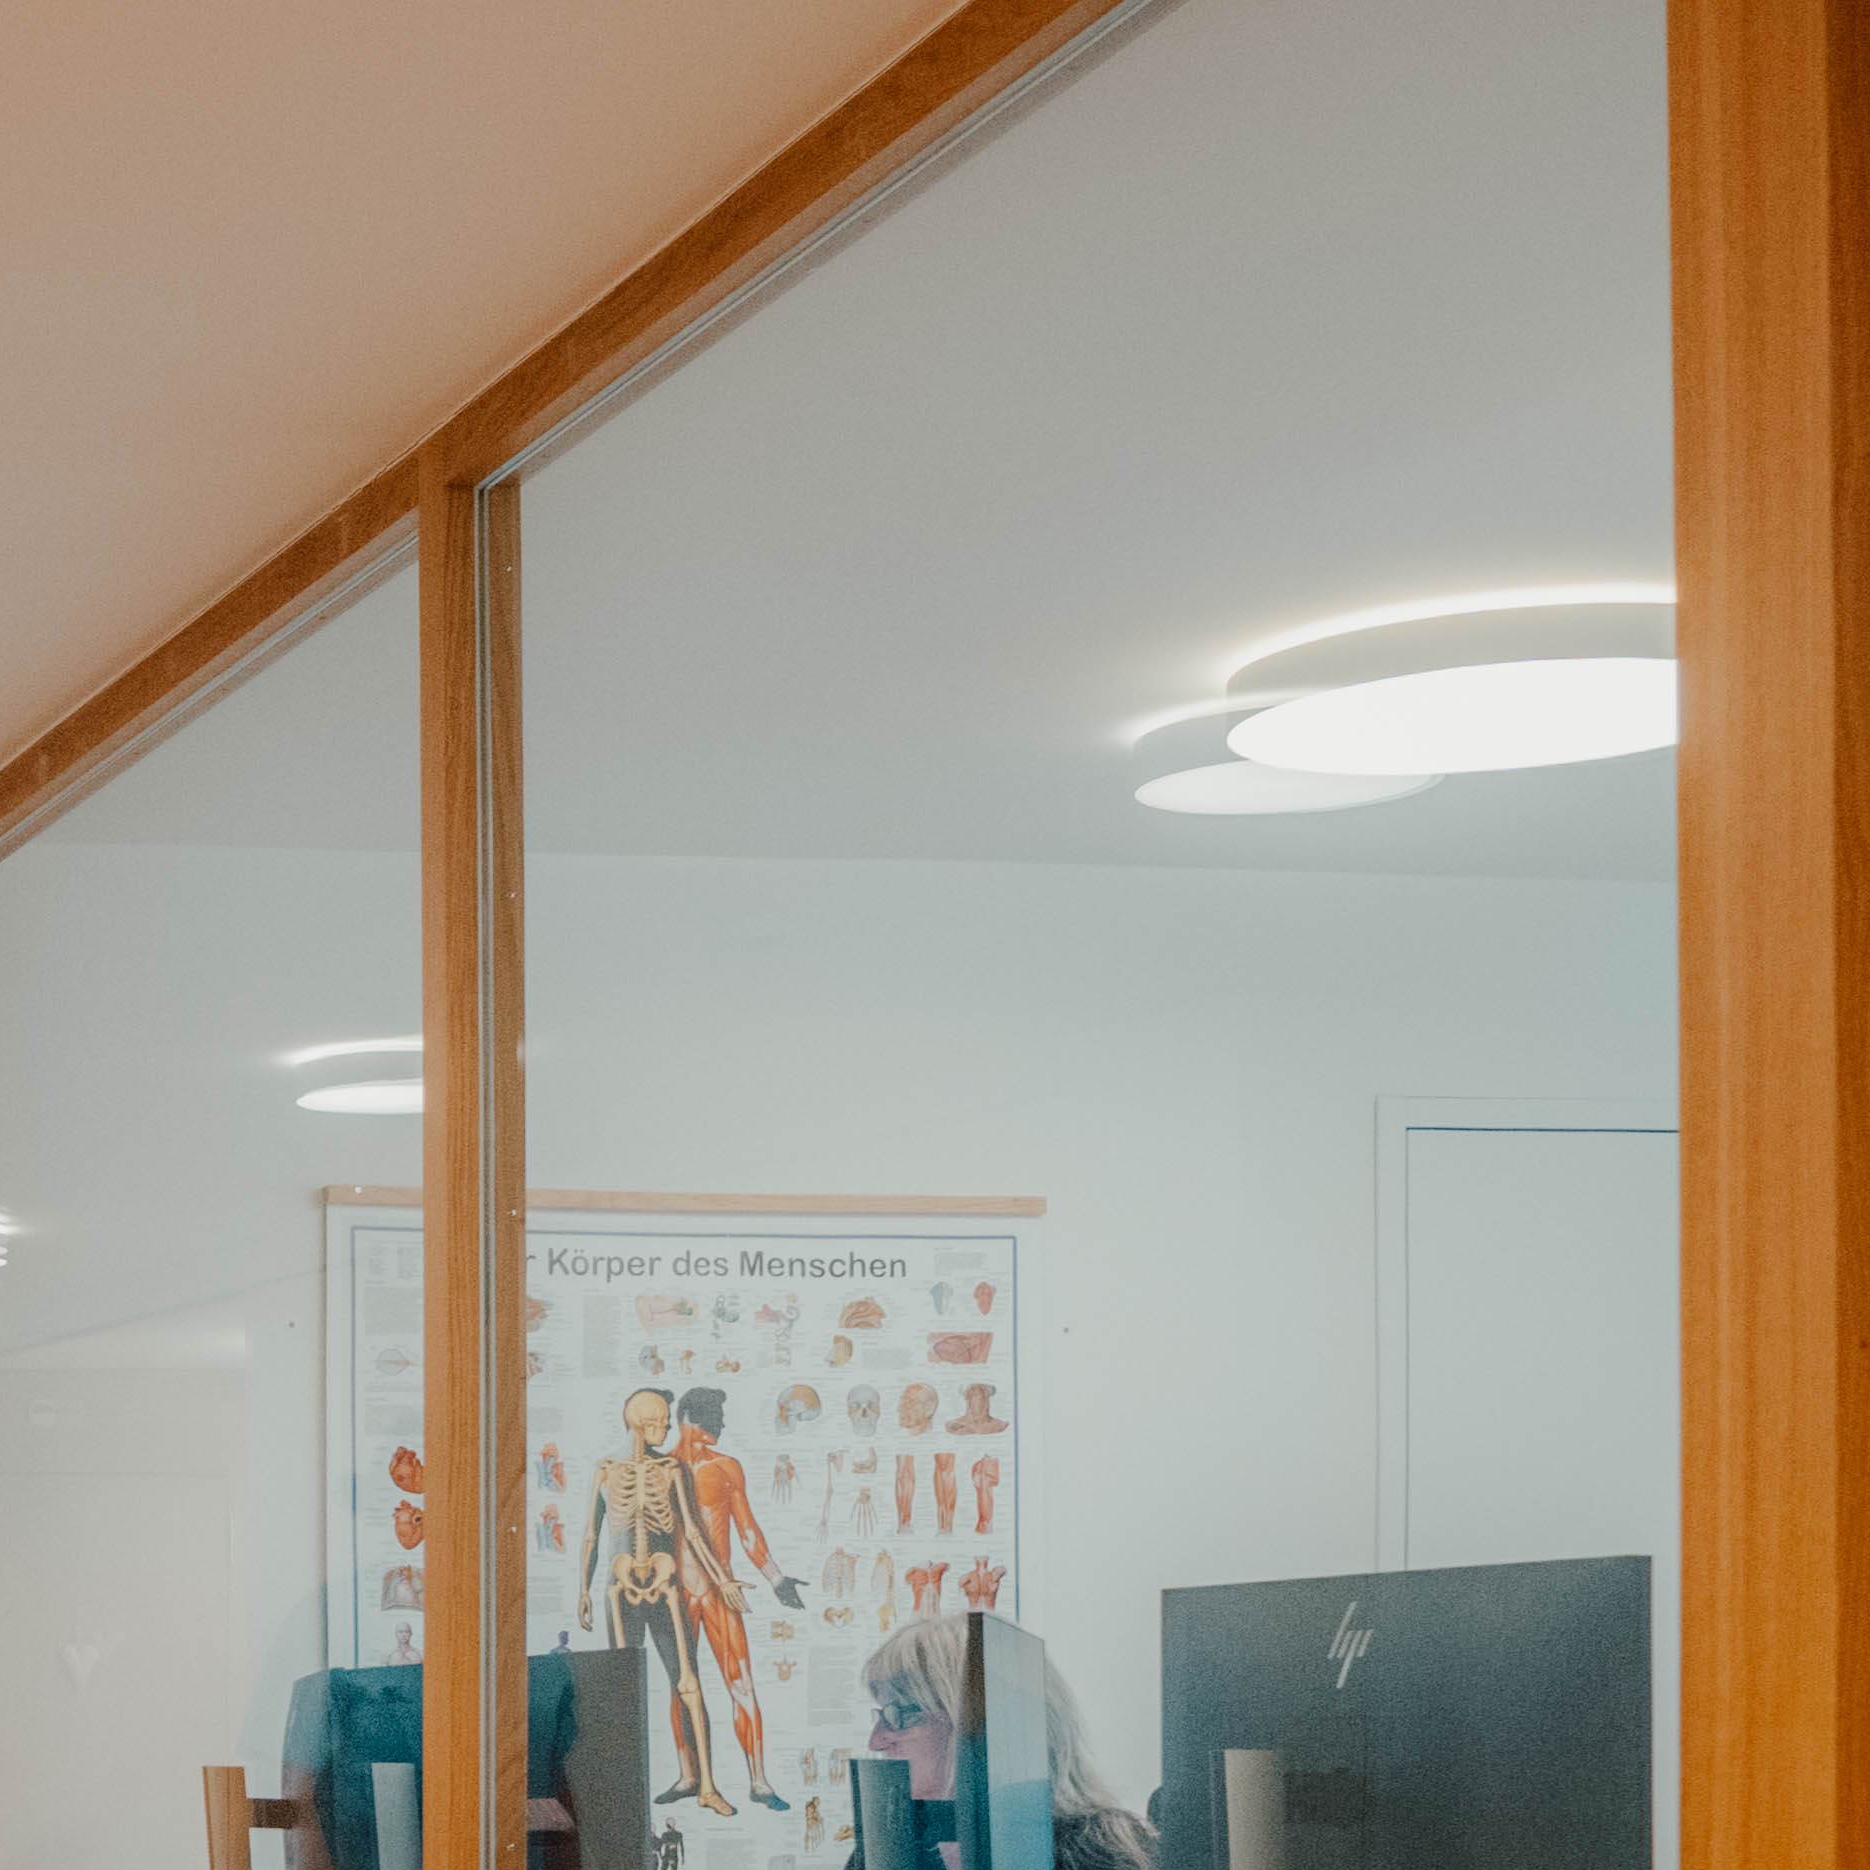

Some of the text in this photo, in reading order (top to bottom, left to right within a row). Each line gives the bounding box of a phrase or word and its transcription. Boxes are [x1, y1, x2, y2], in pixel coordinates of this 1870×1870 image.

[548, 1247, 662, 1284] Körper
[672, 1249, 729, 1278] des
[740, 1250, 907, 1278] Menschen
[1326, 1600, 1375, 1689] hp
